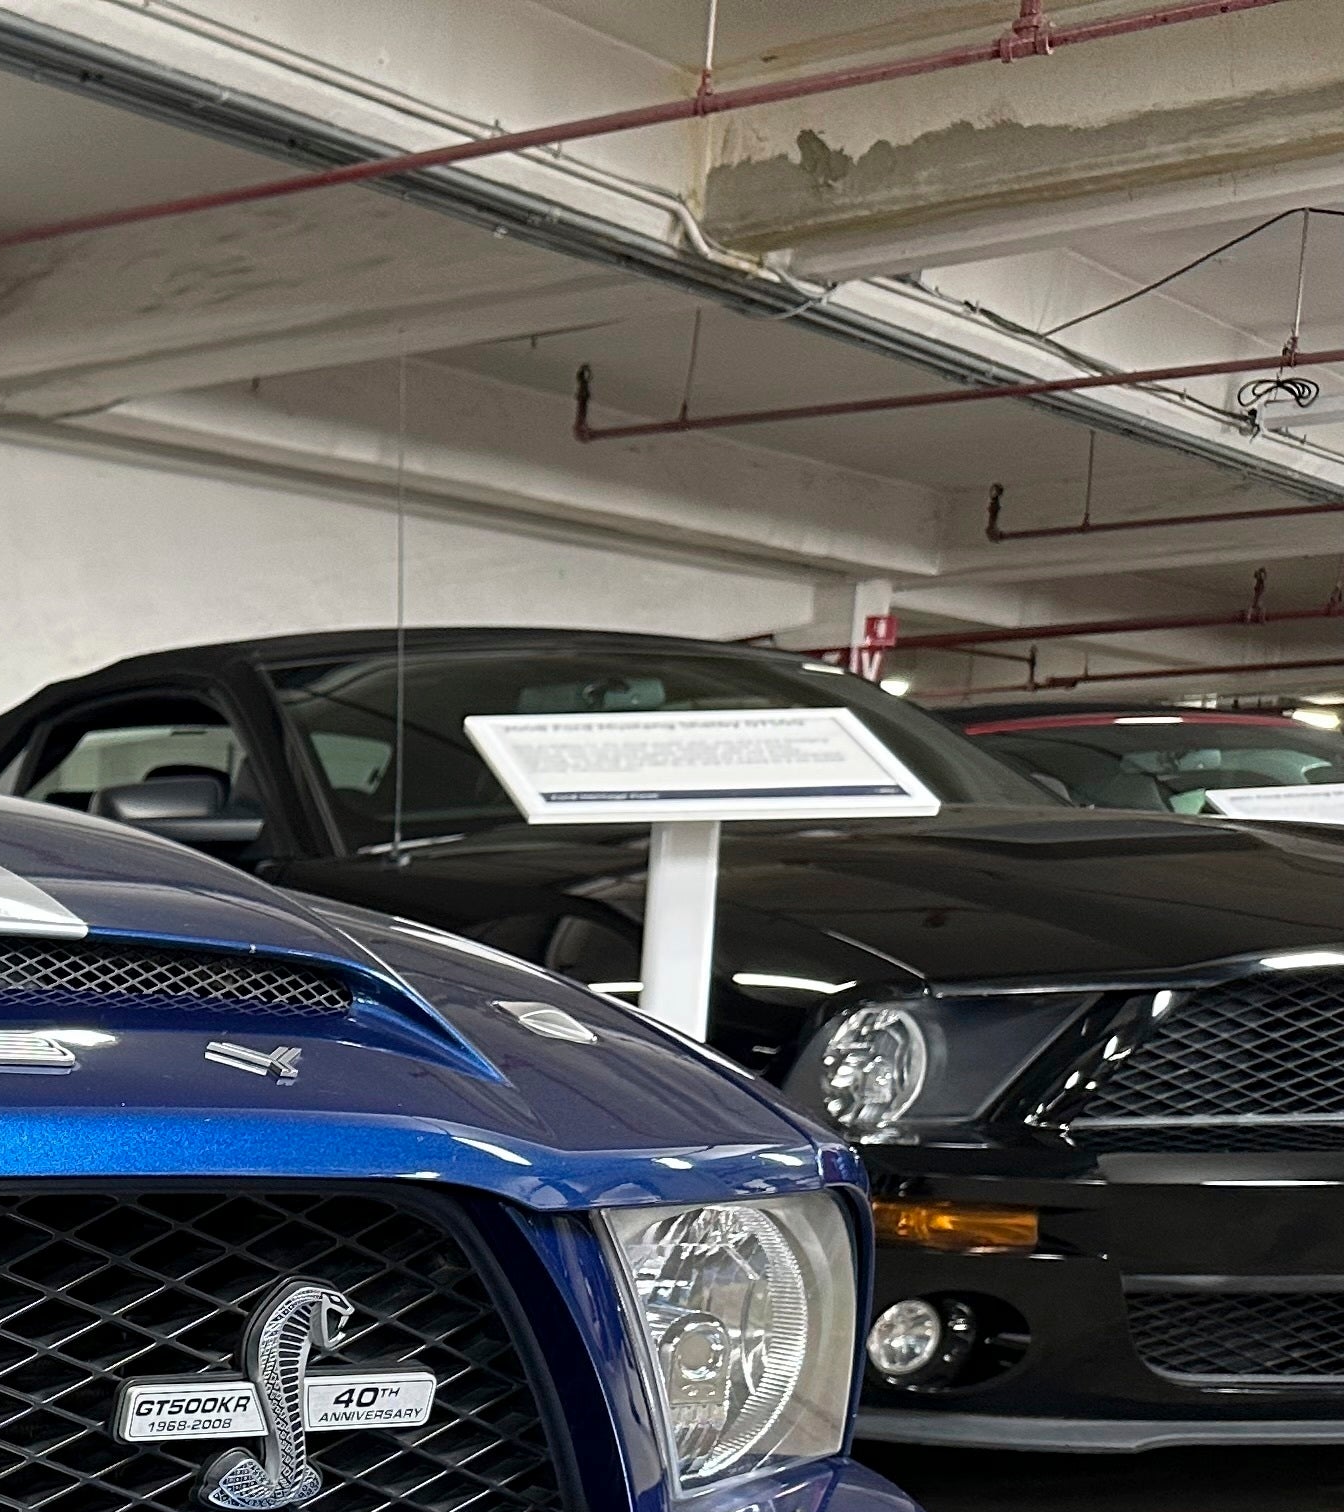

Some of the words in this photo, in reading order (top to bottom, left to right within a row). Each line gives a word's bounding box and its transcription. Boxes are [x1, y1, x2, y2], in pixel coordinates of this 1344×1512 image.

[136, 1396, 250, 1416] GT500KR
[333, 1387, 400, 1408] 40TH
[318, 1408, 423, 1422] ANNIVERSARY
[148, 1418, 232, 1433] 1968-2008
